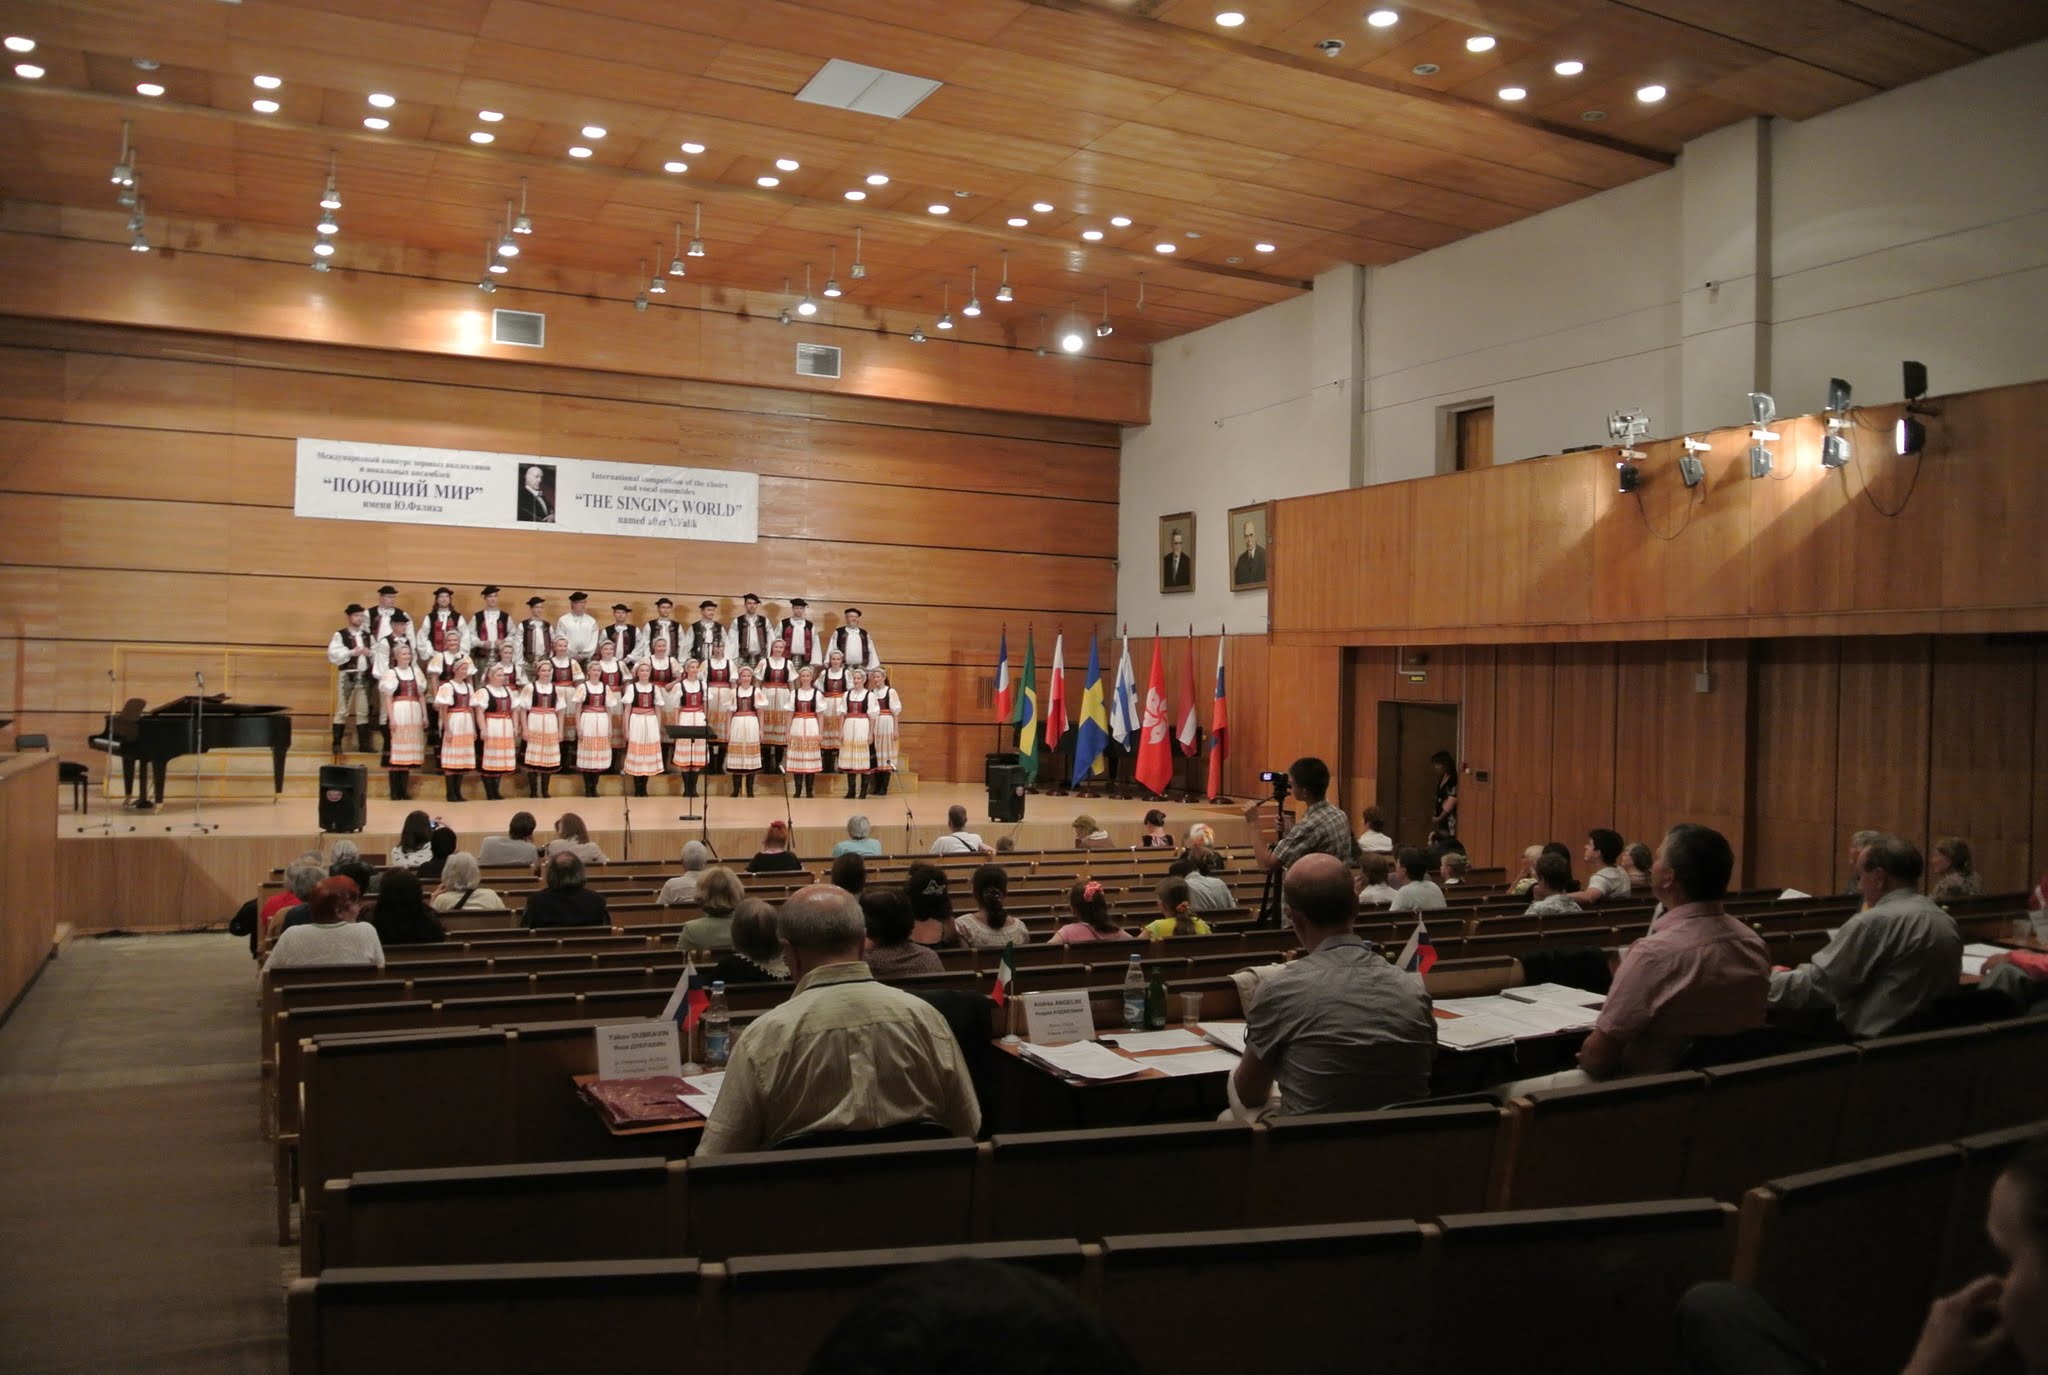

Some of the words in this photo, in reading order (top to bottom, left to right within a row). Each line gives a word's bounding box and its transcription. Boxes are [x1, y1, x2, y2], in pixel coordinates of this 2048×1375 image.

[317, 451, 380, 464] Международный
[591, 472, 639, 482] International
[694, 479, 705, 487] the
[623, 484, 637, 492] and
[362, 500, 392, 510] имени
[394, 500, 443, 512] Ю.Фалика
[617, 495, 678, 514] SINGING
[618, 516, 645, 525] named
[648, 517, 666, 527] after
